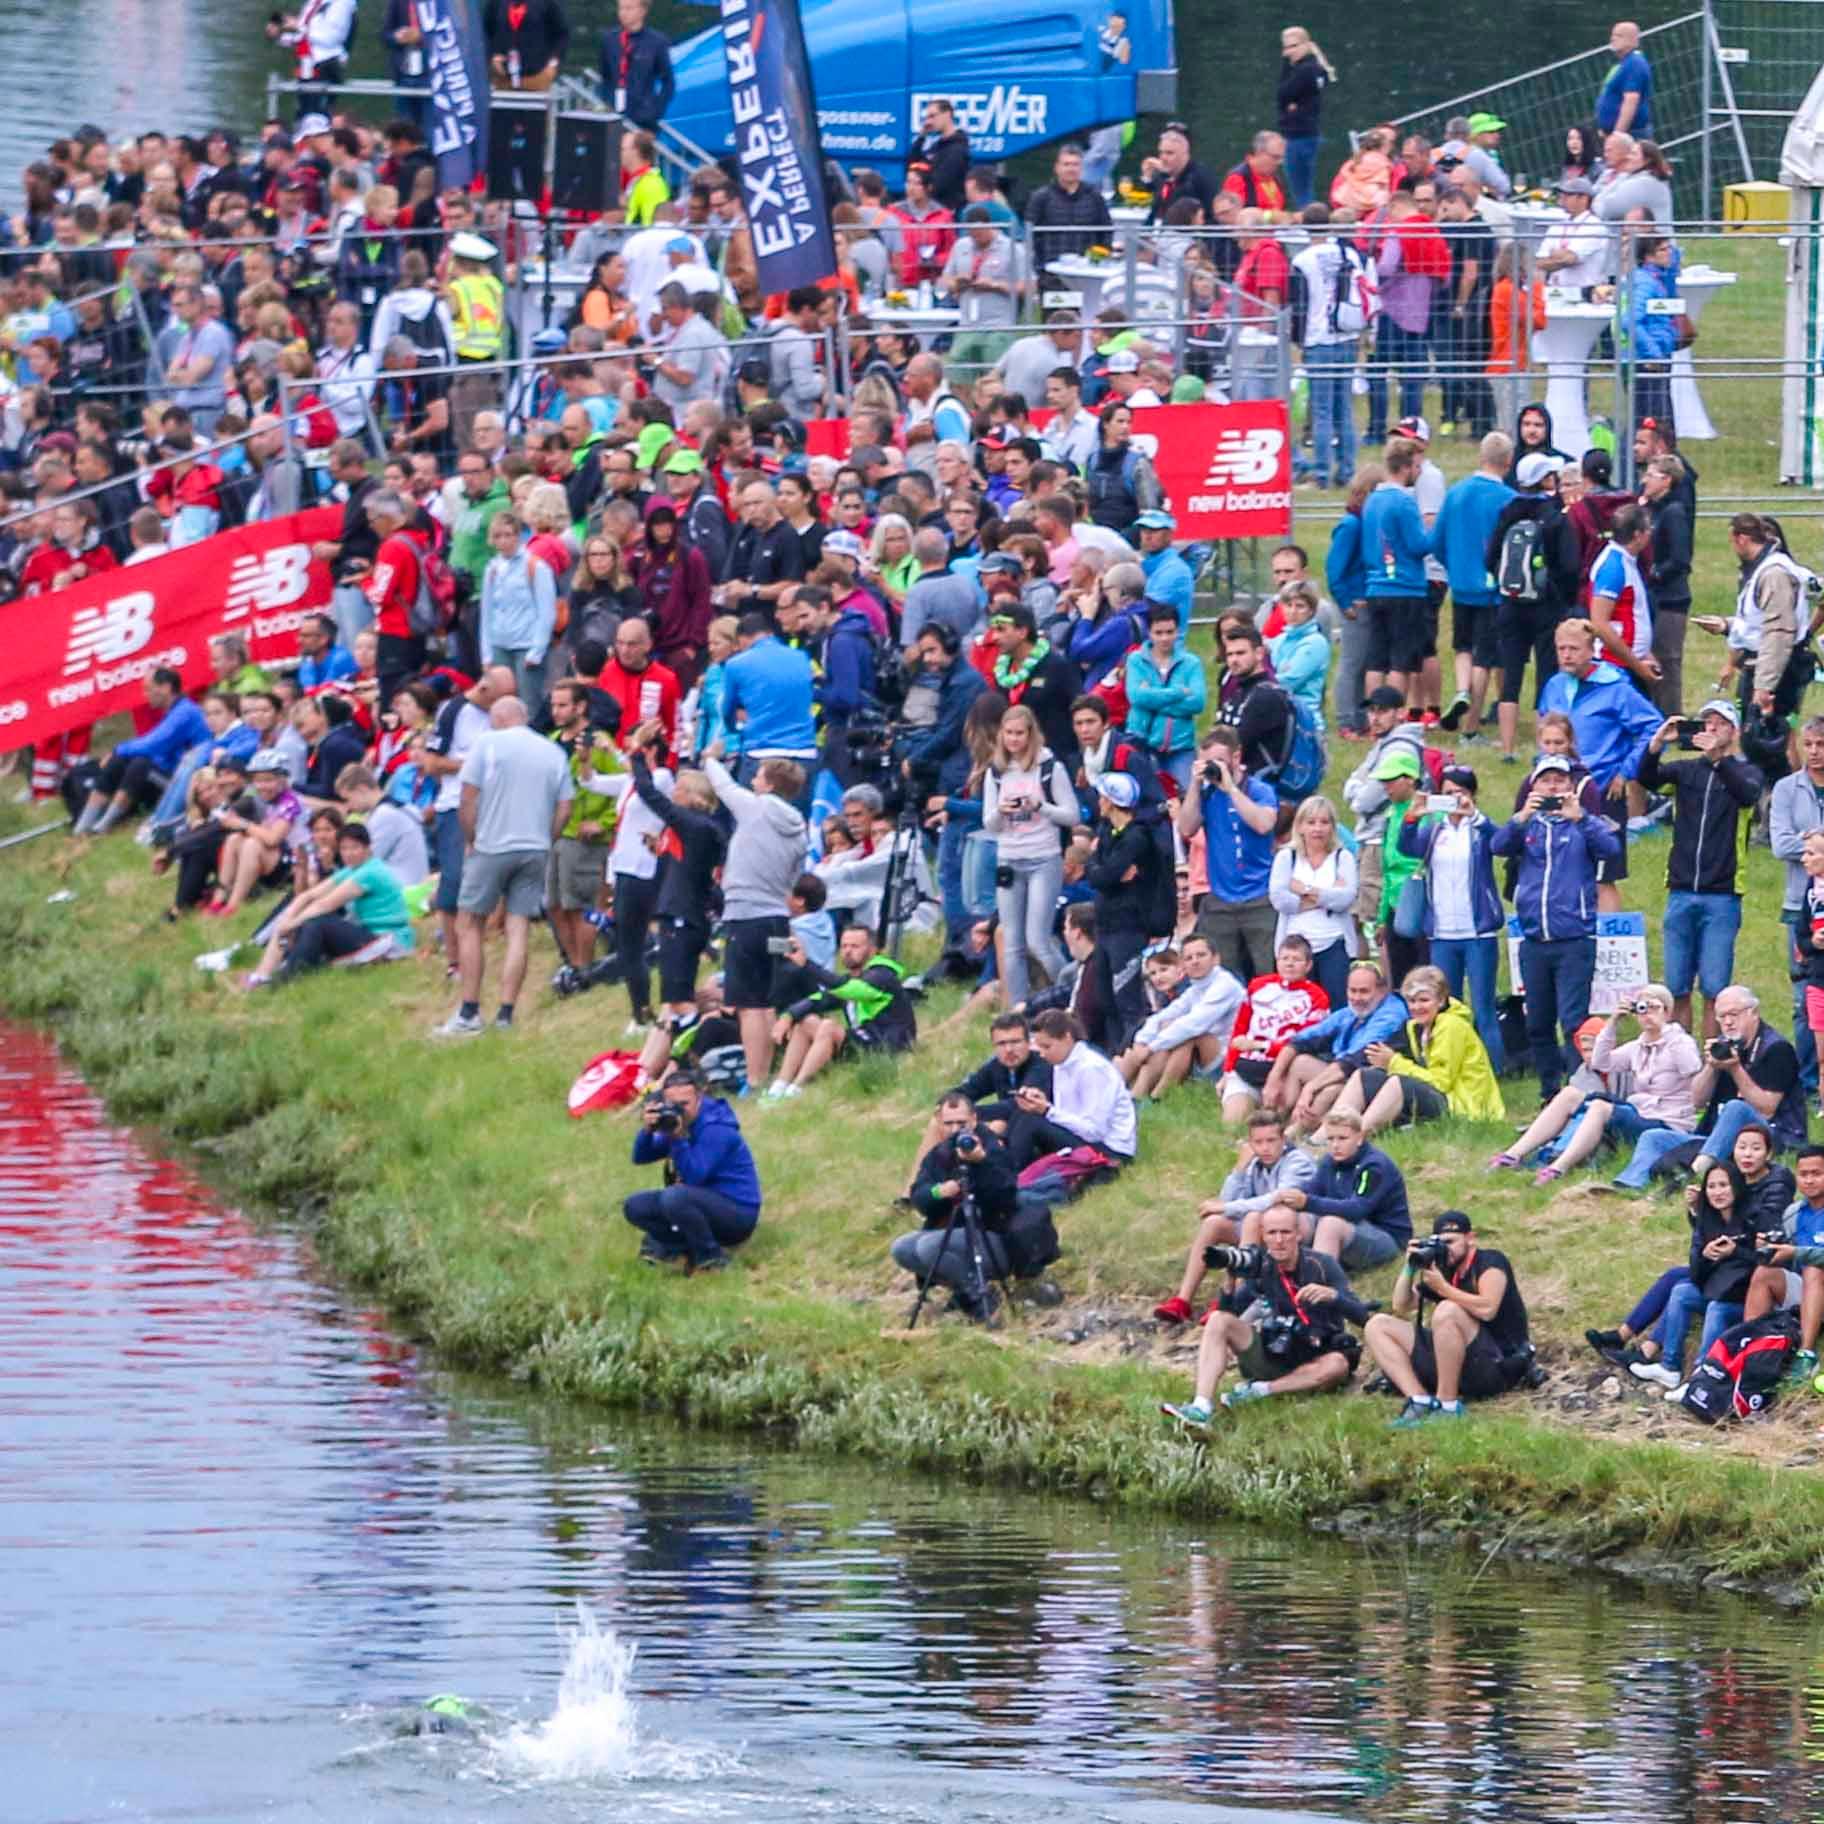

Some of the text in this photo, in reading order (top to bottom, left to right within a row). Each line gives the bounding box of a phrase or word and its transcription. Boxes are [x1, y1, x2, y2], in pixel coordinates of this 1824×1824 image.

[821, 132, 897, 151] hnen.de
[1188, 495, 1225, 513] new
[48, 645, 188, 707] new balance
